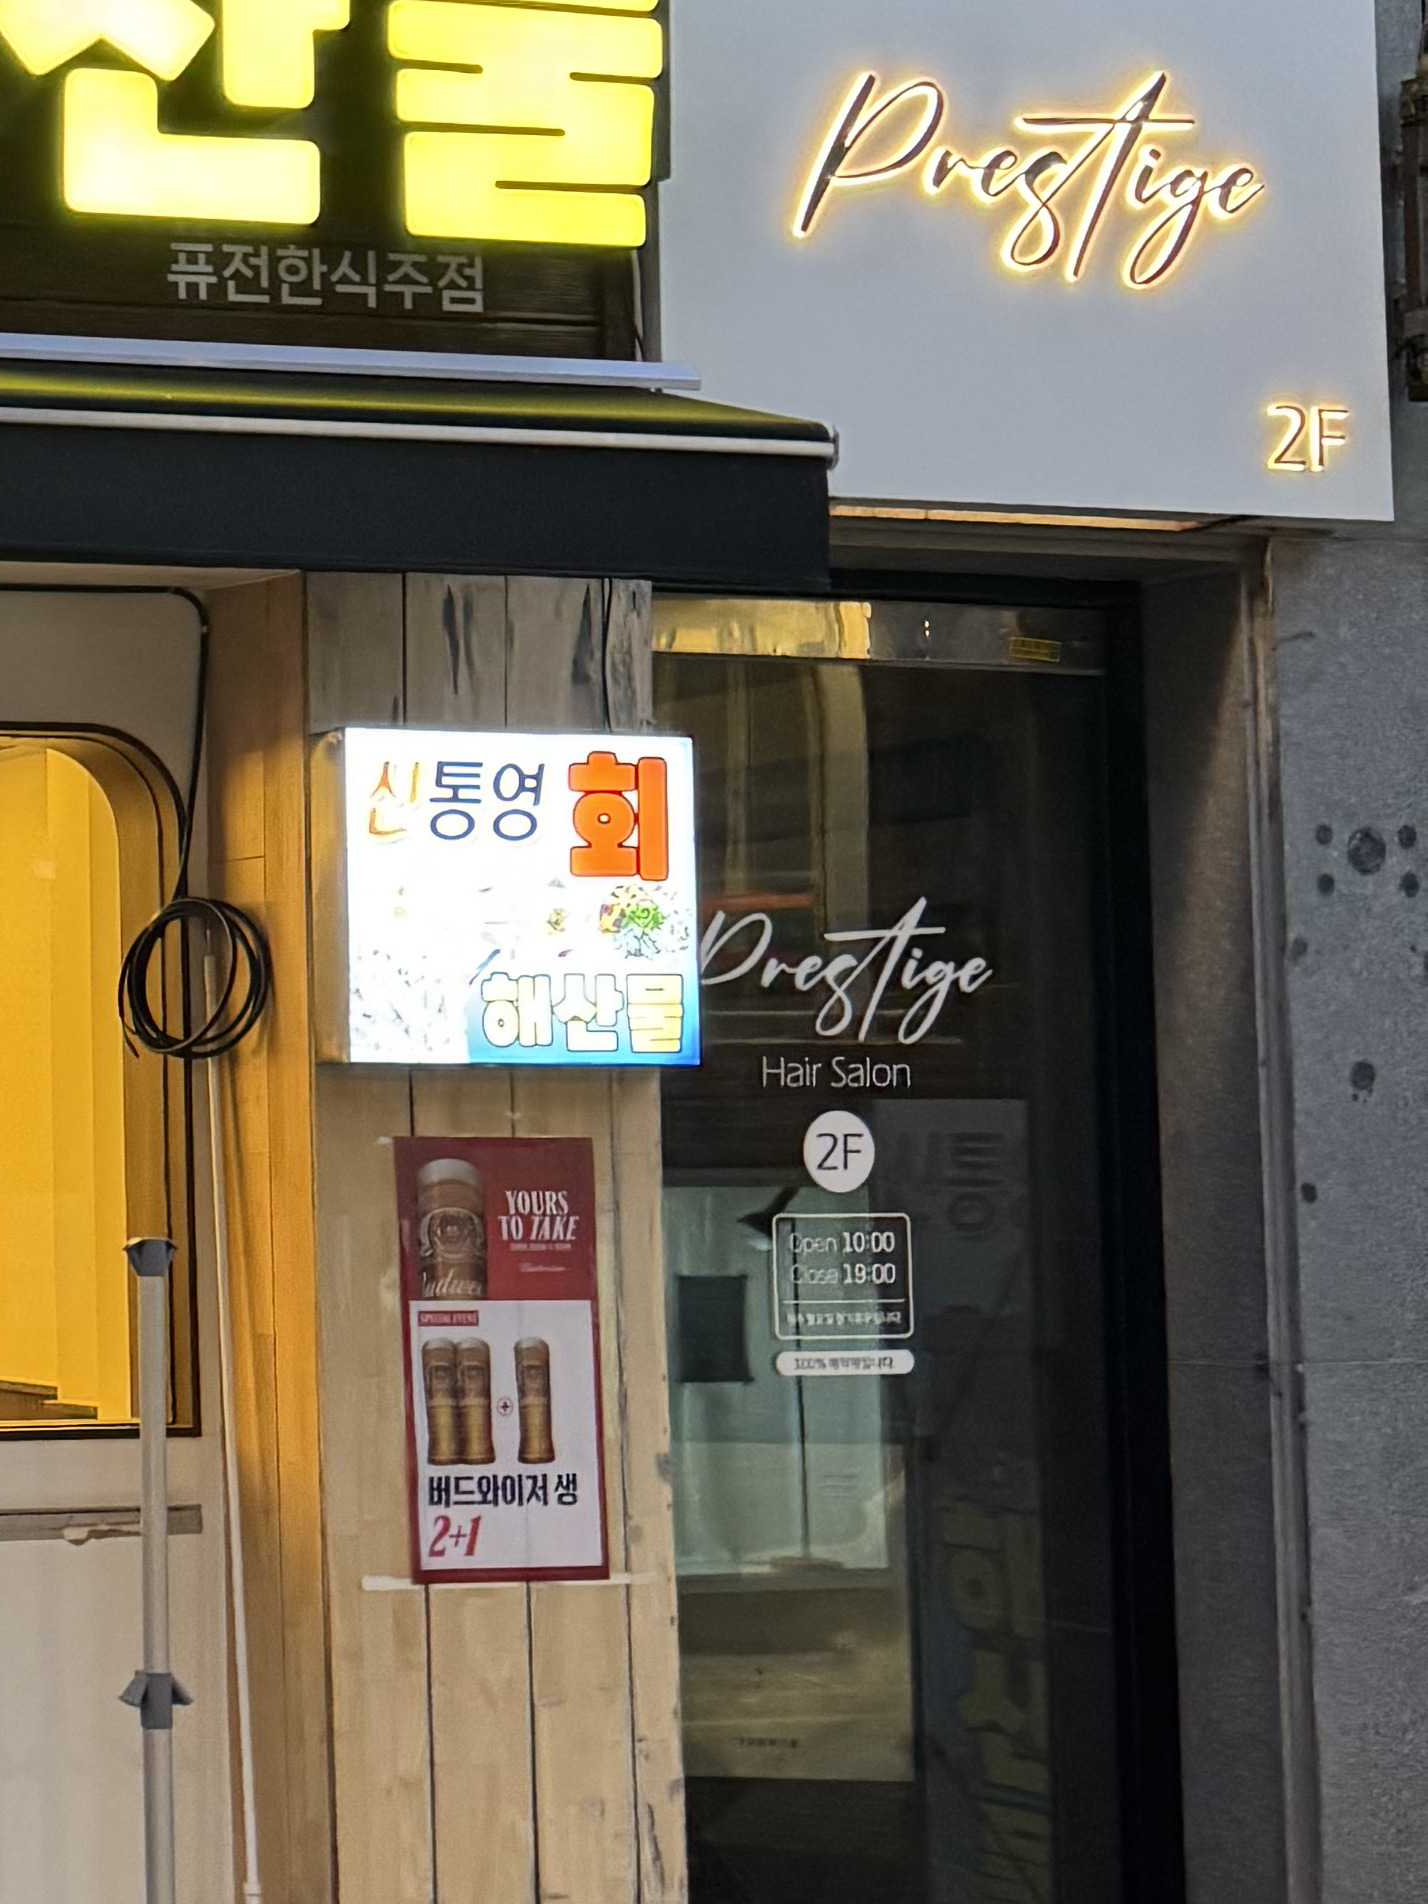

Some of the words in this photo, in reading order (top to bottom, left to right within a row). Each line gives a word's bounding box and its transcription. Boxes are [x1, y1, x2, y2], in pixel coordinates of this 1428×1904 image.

[794, 70, 1265, 288] Prestige
[166, 241, 485, 315] 퓨전한식주점
[1266, 403, 1350, 473] 2F
[368, 760, 544, 842] 신통영
[568, 751, 669, 881] 회
[700, 896, 993, 1044] Prestige
[481, 972, 684, 1054] 해산물
[762, 1057, 821, 1088] Hair
[832, 1057, 911, 1088] Salon
[816, 1132, 864, 1172] 2F
[505, 1190, 569, 1215] YOURS
[497, 1215, 524, 1241] TO
[529, 1215, 580, 1241] TAKE
[842, 1232, 896, 1253] 10:00
[842, 1262, 896, 1284] 19:00
[429, 1473, 549, 1508] 버드와이저
[555, 1472, 579, 1506] 생
[429, 1515, 483, 1558] 2+1
